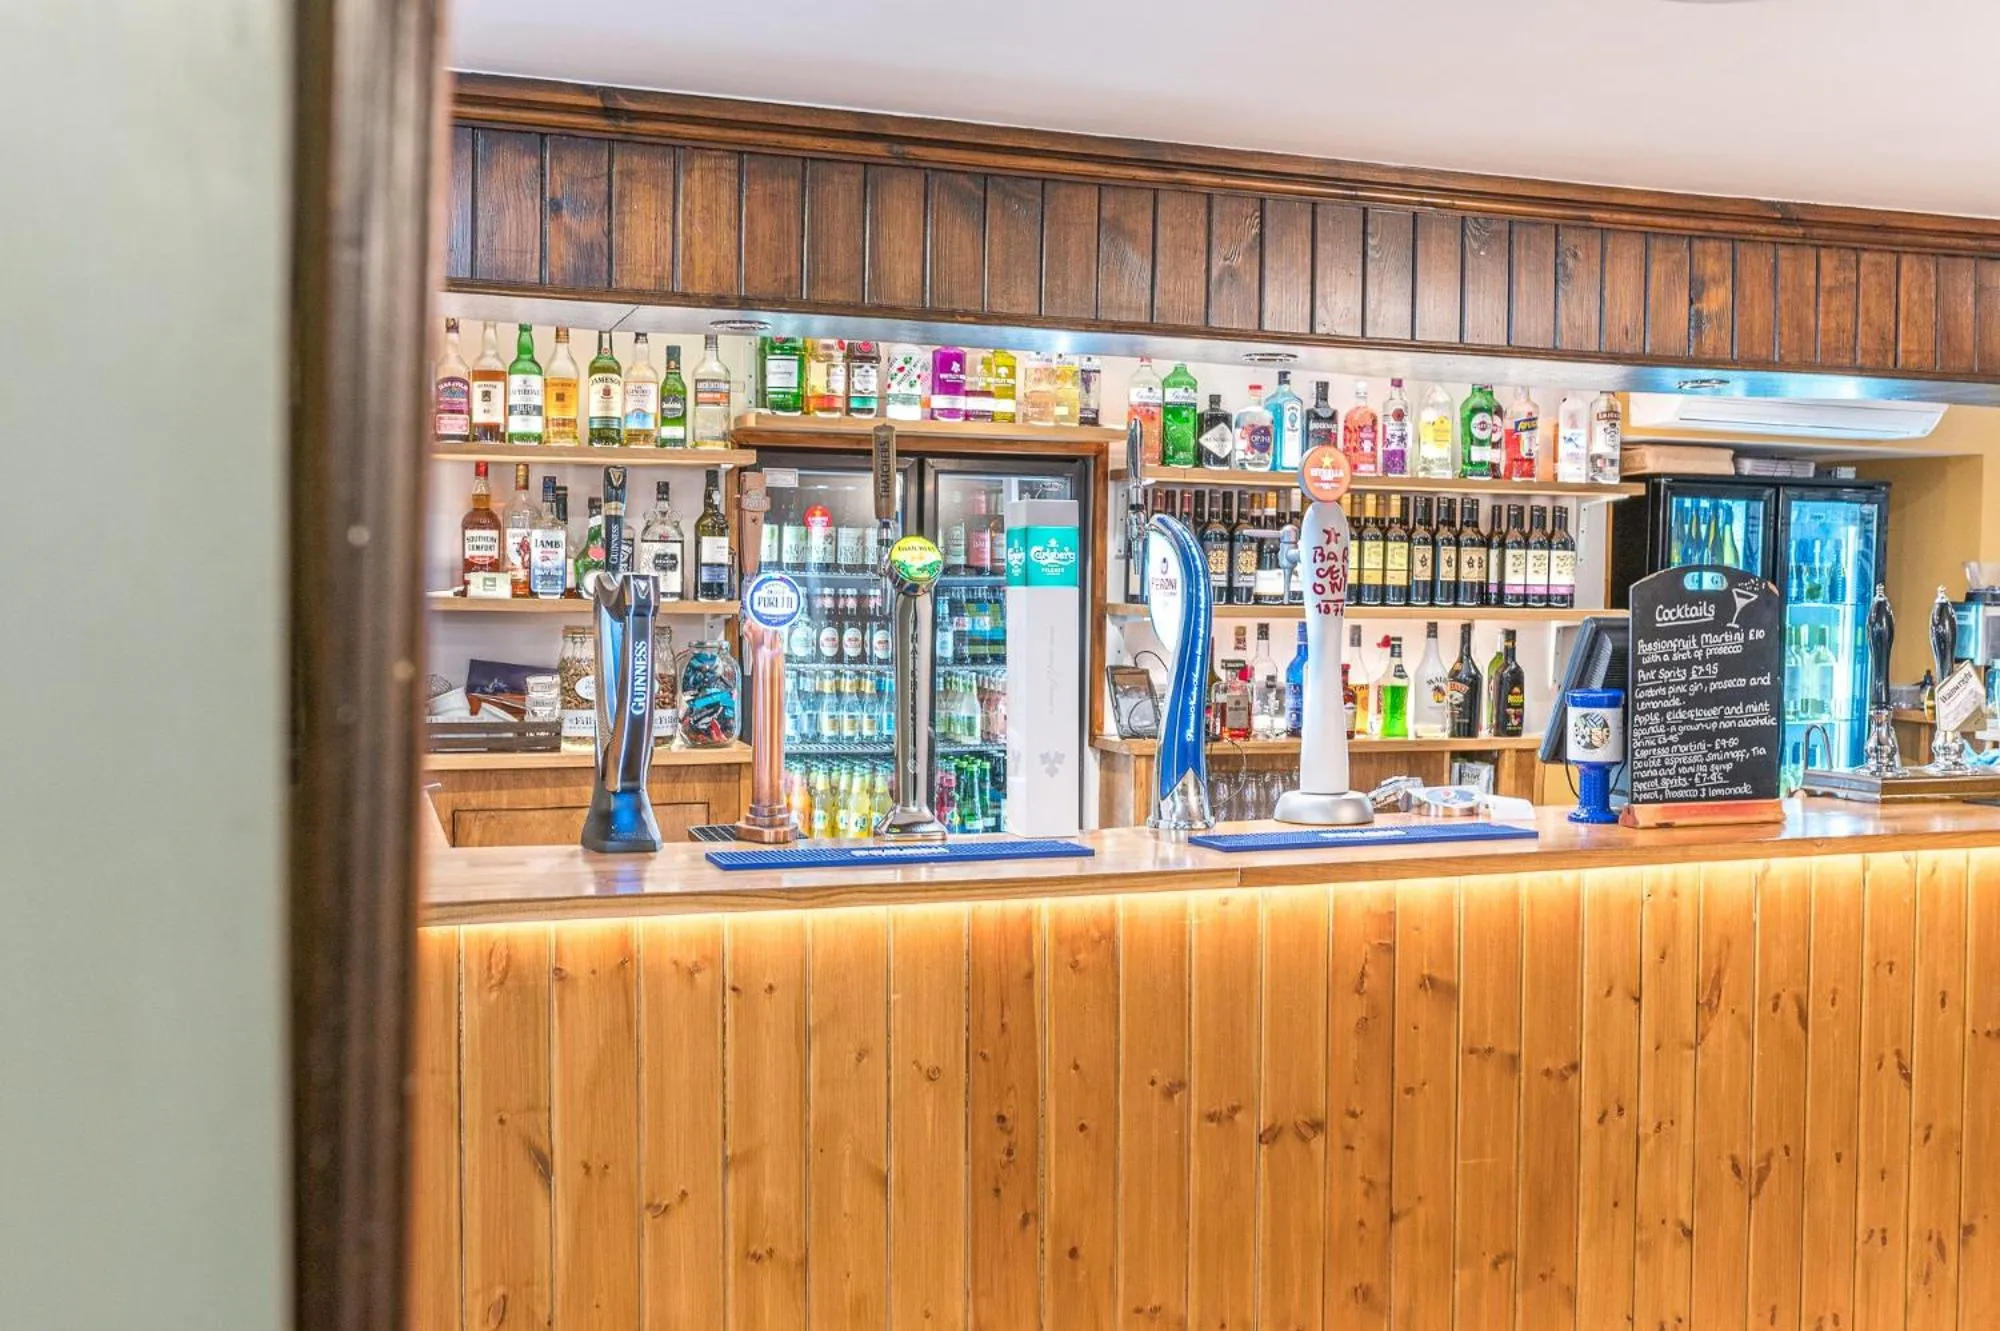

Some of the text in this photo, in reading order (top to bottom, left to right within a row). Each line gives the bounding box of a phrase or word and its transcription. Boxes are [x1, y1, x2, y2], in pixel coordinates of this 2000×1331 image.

[590, 375, 621, 387] JAMESON
[610, 523, 620, 564] GUINNESS
[1030, 546, 1076, 566] Carlsberg
[1655, 601, 1716, 621] Cocktails
[1638, 634, 1698, 655] Passionfruit
[1748, 629, 1766, 641] £10
[1642, 645, 1743, 664] with a shot of prosecco
[631, 640, 648, 716] GUINNESS
[1637, 668, 1657, 683] Pink
[1667, 684, 1688, 699] pink
[1709, 678, 1747, 693] prosecco
[1750, 672, 1771, 686] and
[1723, 701, 1744, 716] and
[1745, 700, 1770, 713] mint
[1719, 720, 1737, 729] non
[1750, 746, 1767, 757] Tia
[1659, 767, 1676, 777] and
[1677, 763, 1708, 774] vanilla
[1709, 762, 1733, 774] syrup
